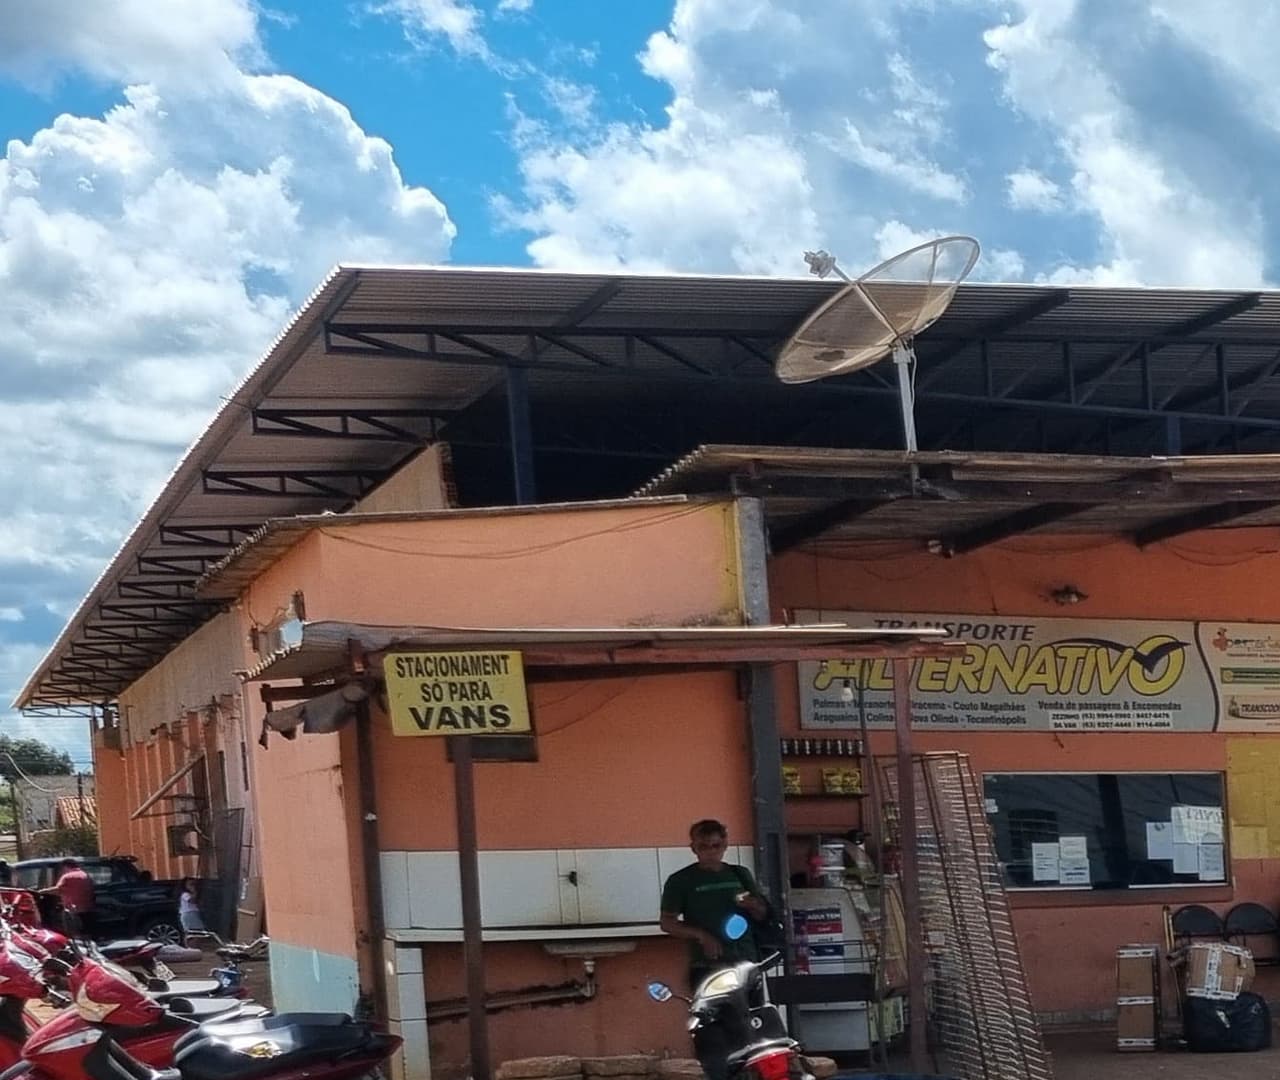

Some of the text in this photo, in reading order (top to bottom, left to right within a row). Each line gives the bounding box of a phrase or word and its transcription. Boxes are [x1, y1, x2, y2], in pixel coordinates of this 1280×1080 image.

[395, 654, 511, 678] STACIONAMENT
[814, 635, 1187, 696] ALERNATIVO
[449, 681, 493, 701] PARA
[408, 704, 511, 730] VANS
[953, 702, 979, 711] Couto
[930, 714, 959, 723] Olinda
